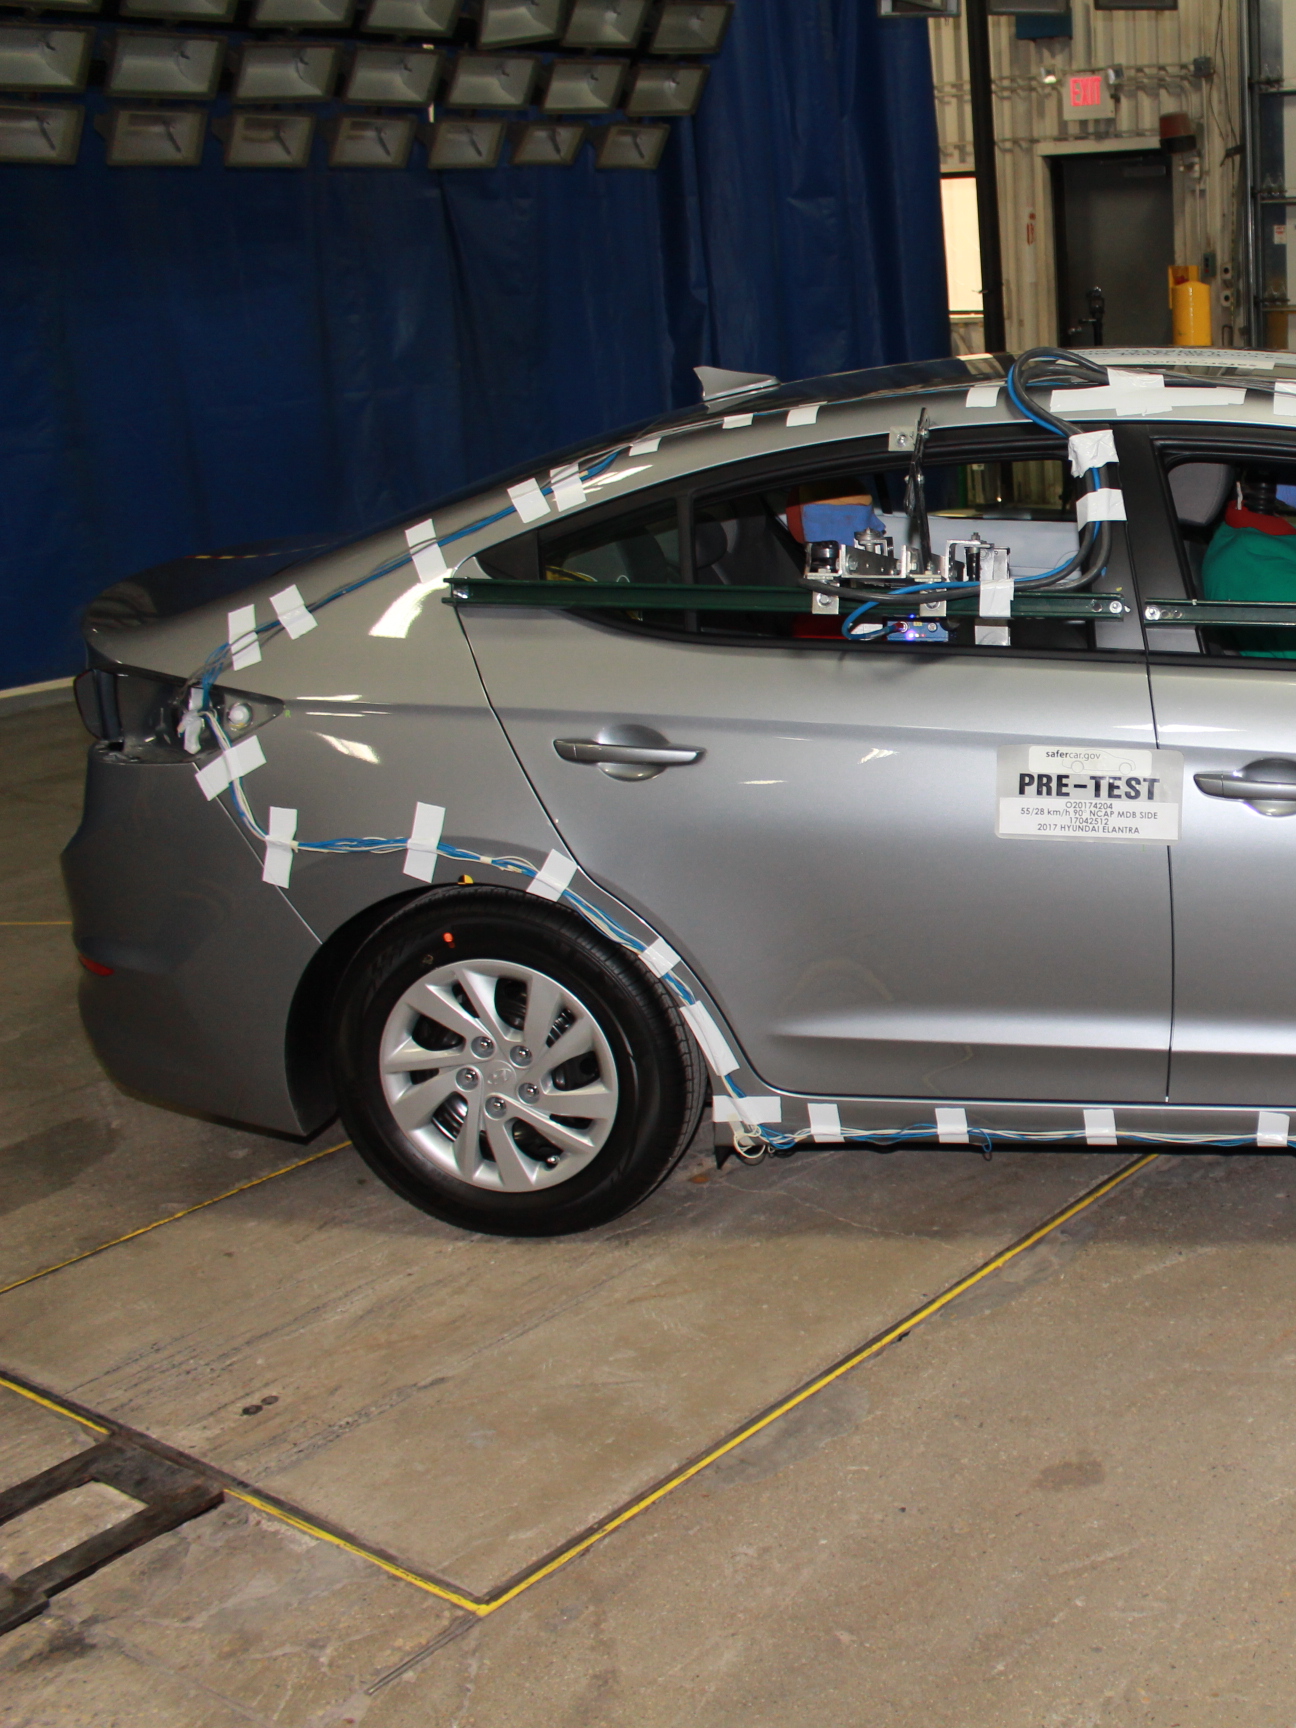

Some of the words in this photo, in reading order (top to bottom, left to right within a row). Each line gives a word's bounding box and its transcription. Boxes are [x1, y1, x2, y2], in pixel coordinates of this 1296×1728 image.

[1070, 76, 1102, 106] EXIT
[1045, 749, 1101, 761] safercar.gov
[1018, 773, 1160, 801] PRE-TEST
[1020, 807, 1045, 816] 55/28
[1047, 808, 1071, 817] km/h
[1089, 810, 1115, 818] NCAP
[1117, 811, 1137, 819] MDB
[1139, 811, 1158, 820] SIDE
[1069, 816, 1109, 826] 17042512
[1037, 823, 1057, 831] 2017
[1060, 824, 1100, 833] HYUNDAI
[1102, 825, 1140, 834] ELANTRA
